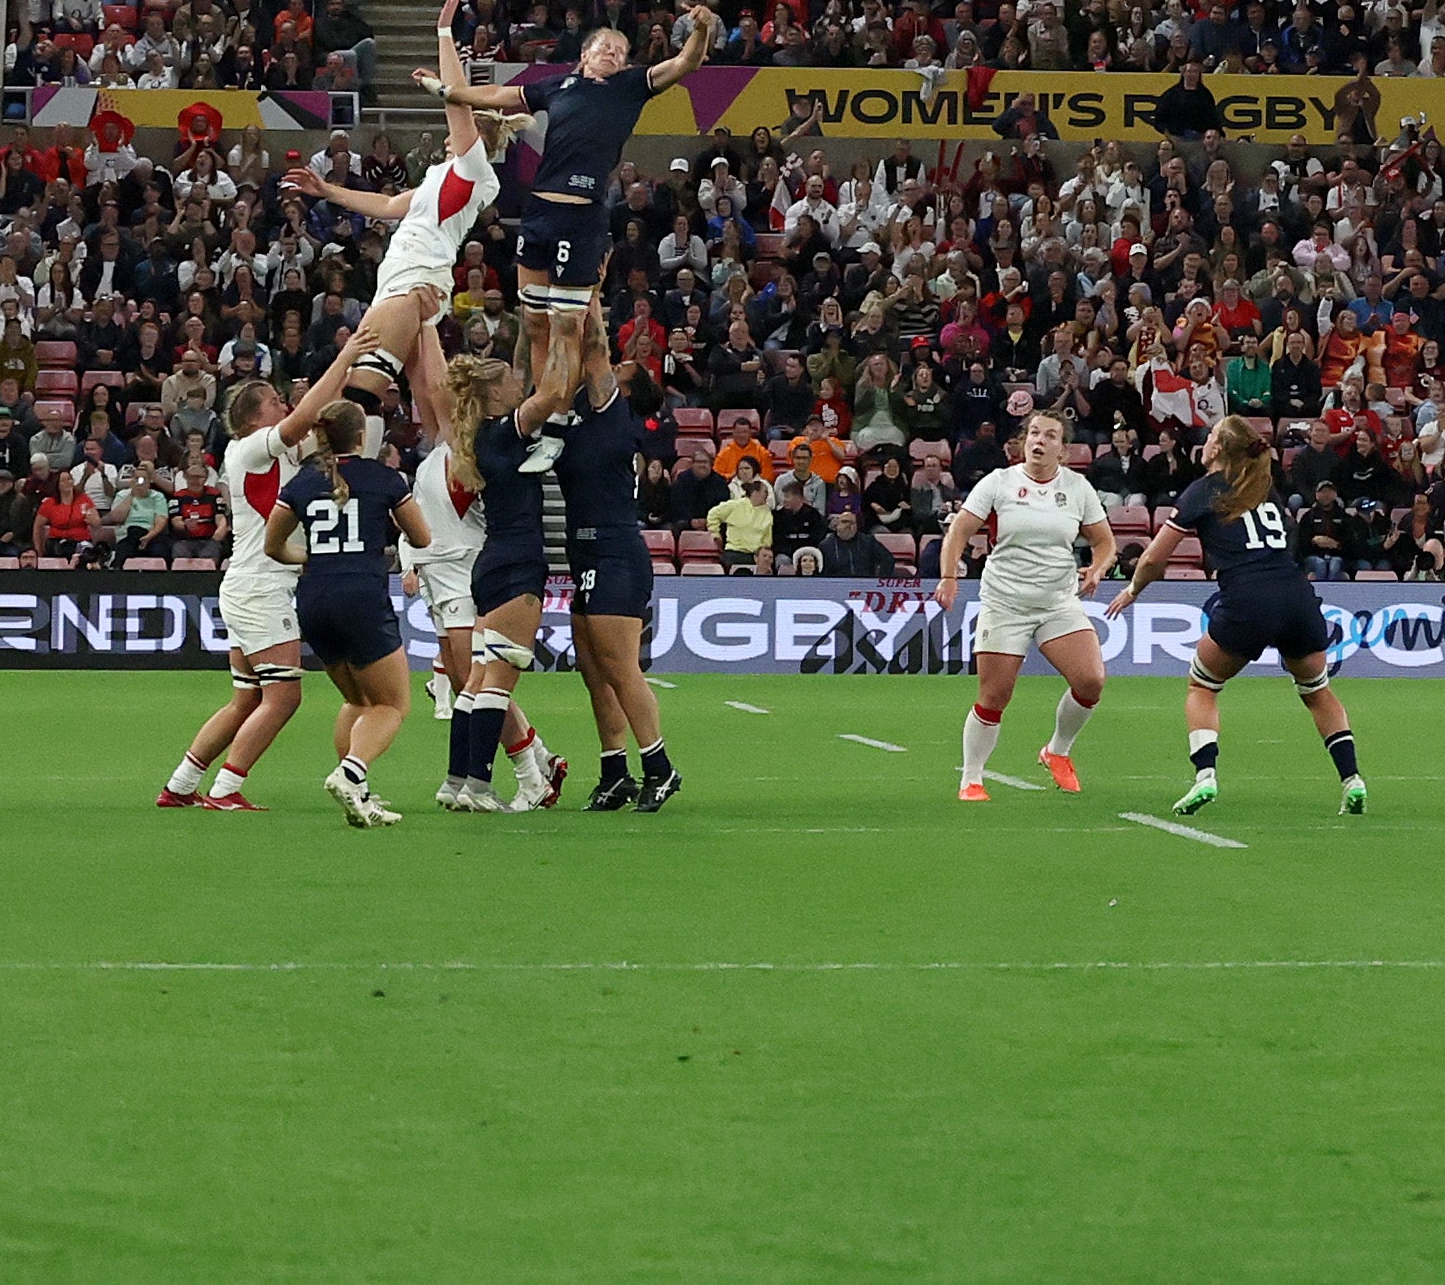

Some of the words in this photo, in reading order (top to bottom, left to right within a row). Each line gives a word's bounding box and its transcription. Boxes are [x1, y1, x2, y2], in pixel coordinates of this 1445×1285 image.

[1123, 95, 1341, 132] RGBY
[557, 240, 571, 263] 6
[306, 498, 365, 555] 21
[1239, 502, 1288, 551] 19
[580, 569, 597, 591] 18
